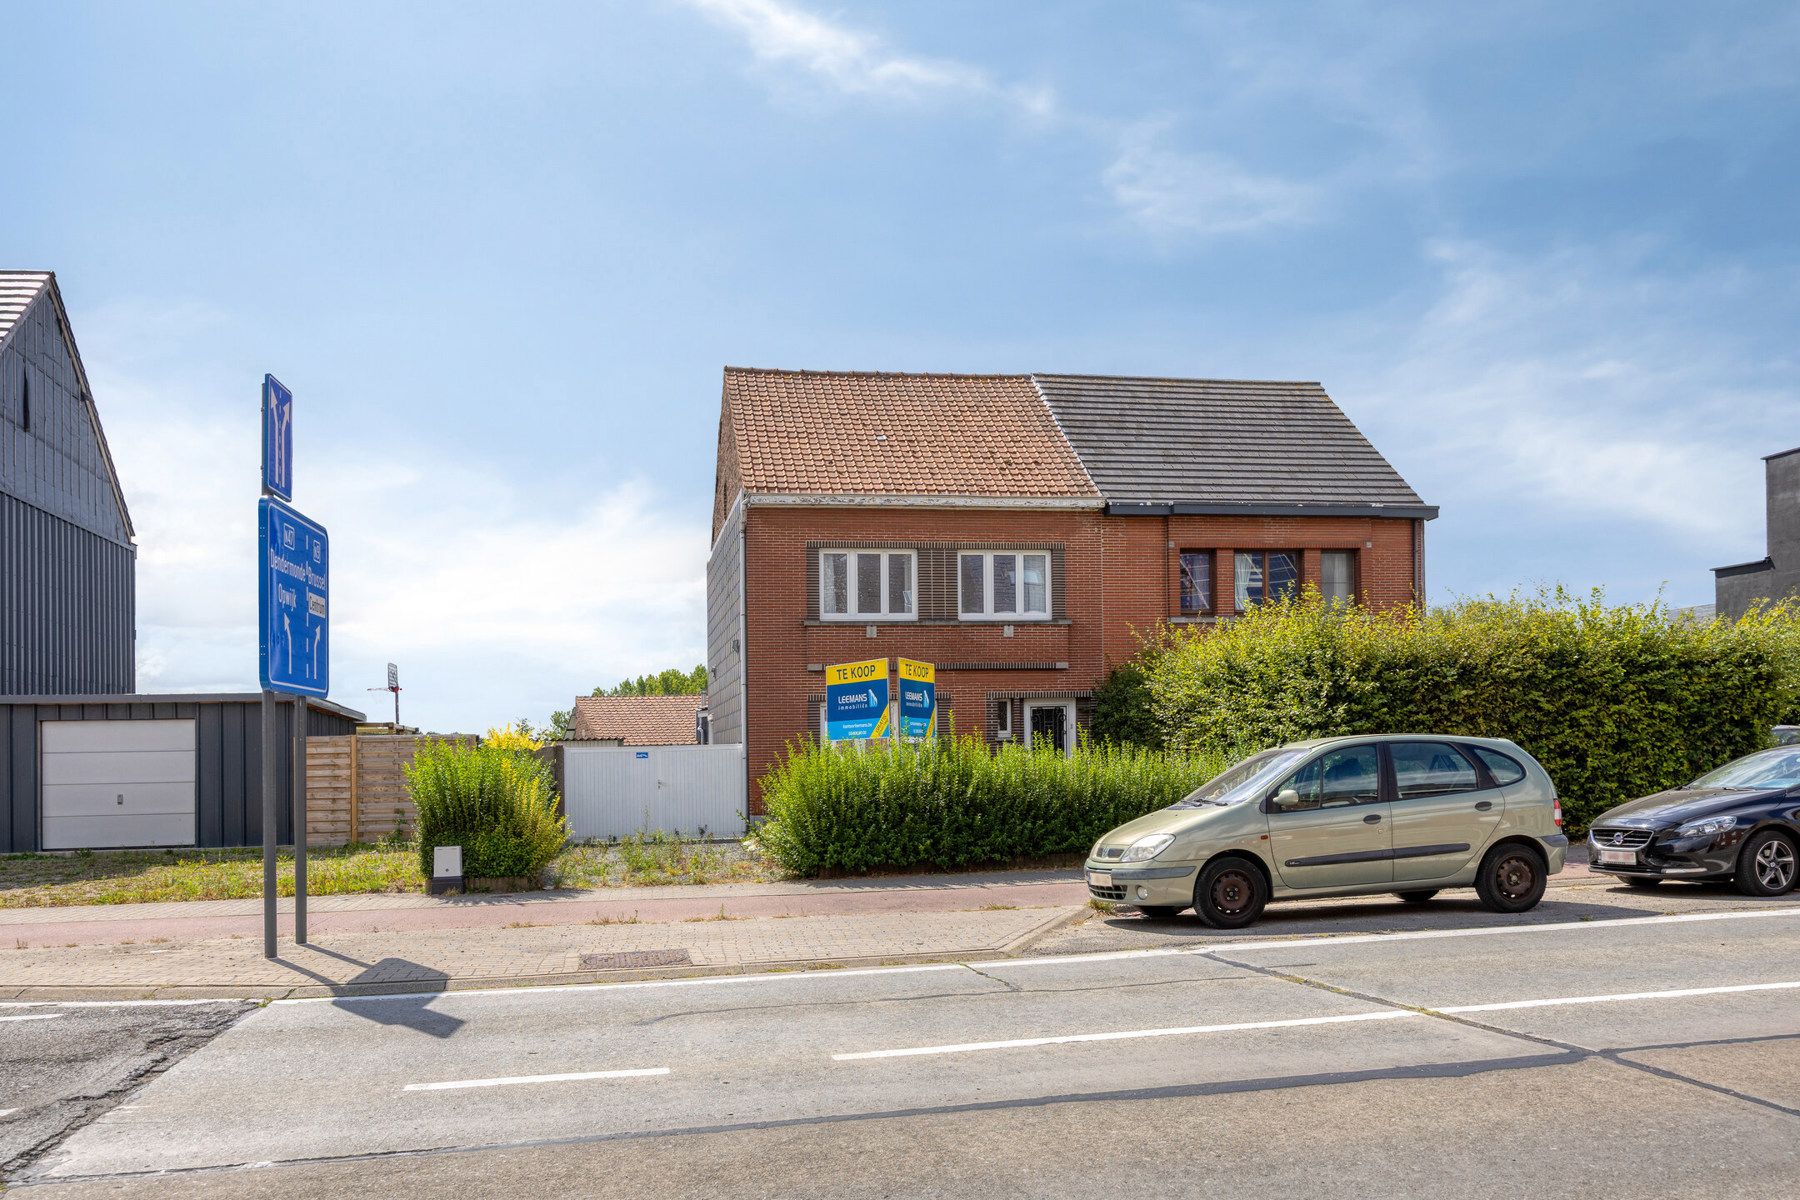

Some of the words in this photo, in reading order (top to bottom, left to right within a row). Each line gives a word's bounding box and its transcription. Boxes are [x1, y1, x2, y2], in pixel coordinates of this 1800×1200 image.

[270, 547, 306, 582] Dendermonde
[278, 583, 297, 612] Opwijk
[836, 669, 848, 680] TE
[851, 665, 876, 679] KOOP
[905, 663, 912, 676] TE
[913, 665, 929, 679] KOOP
[838, 693, 868, 704] LEEMANS
[905, 691, 923, 701] LEEMANS
